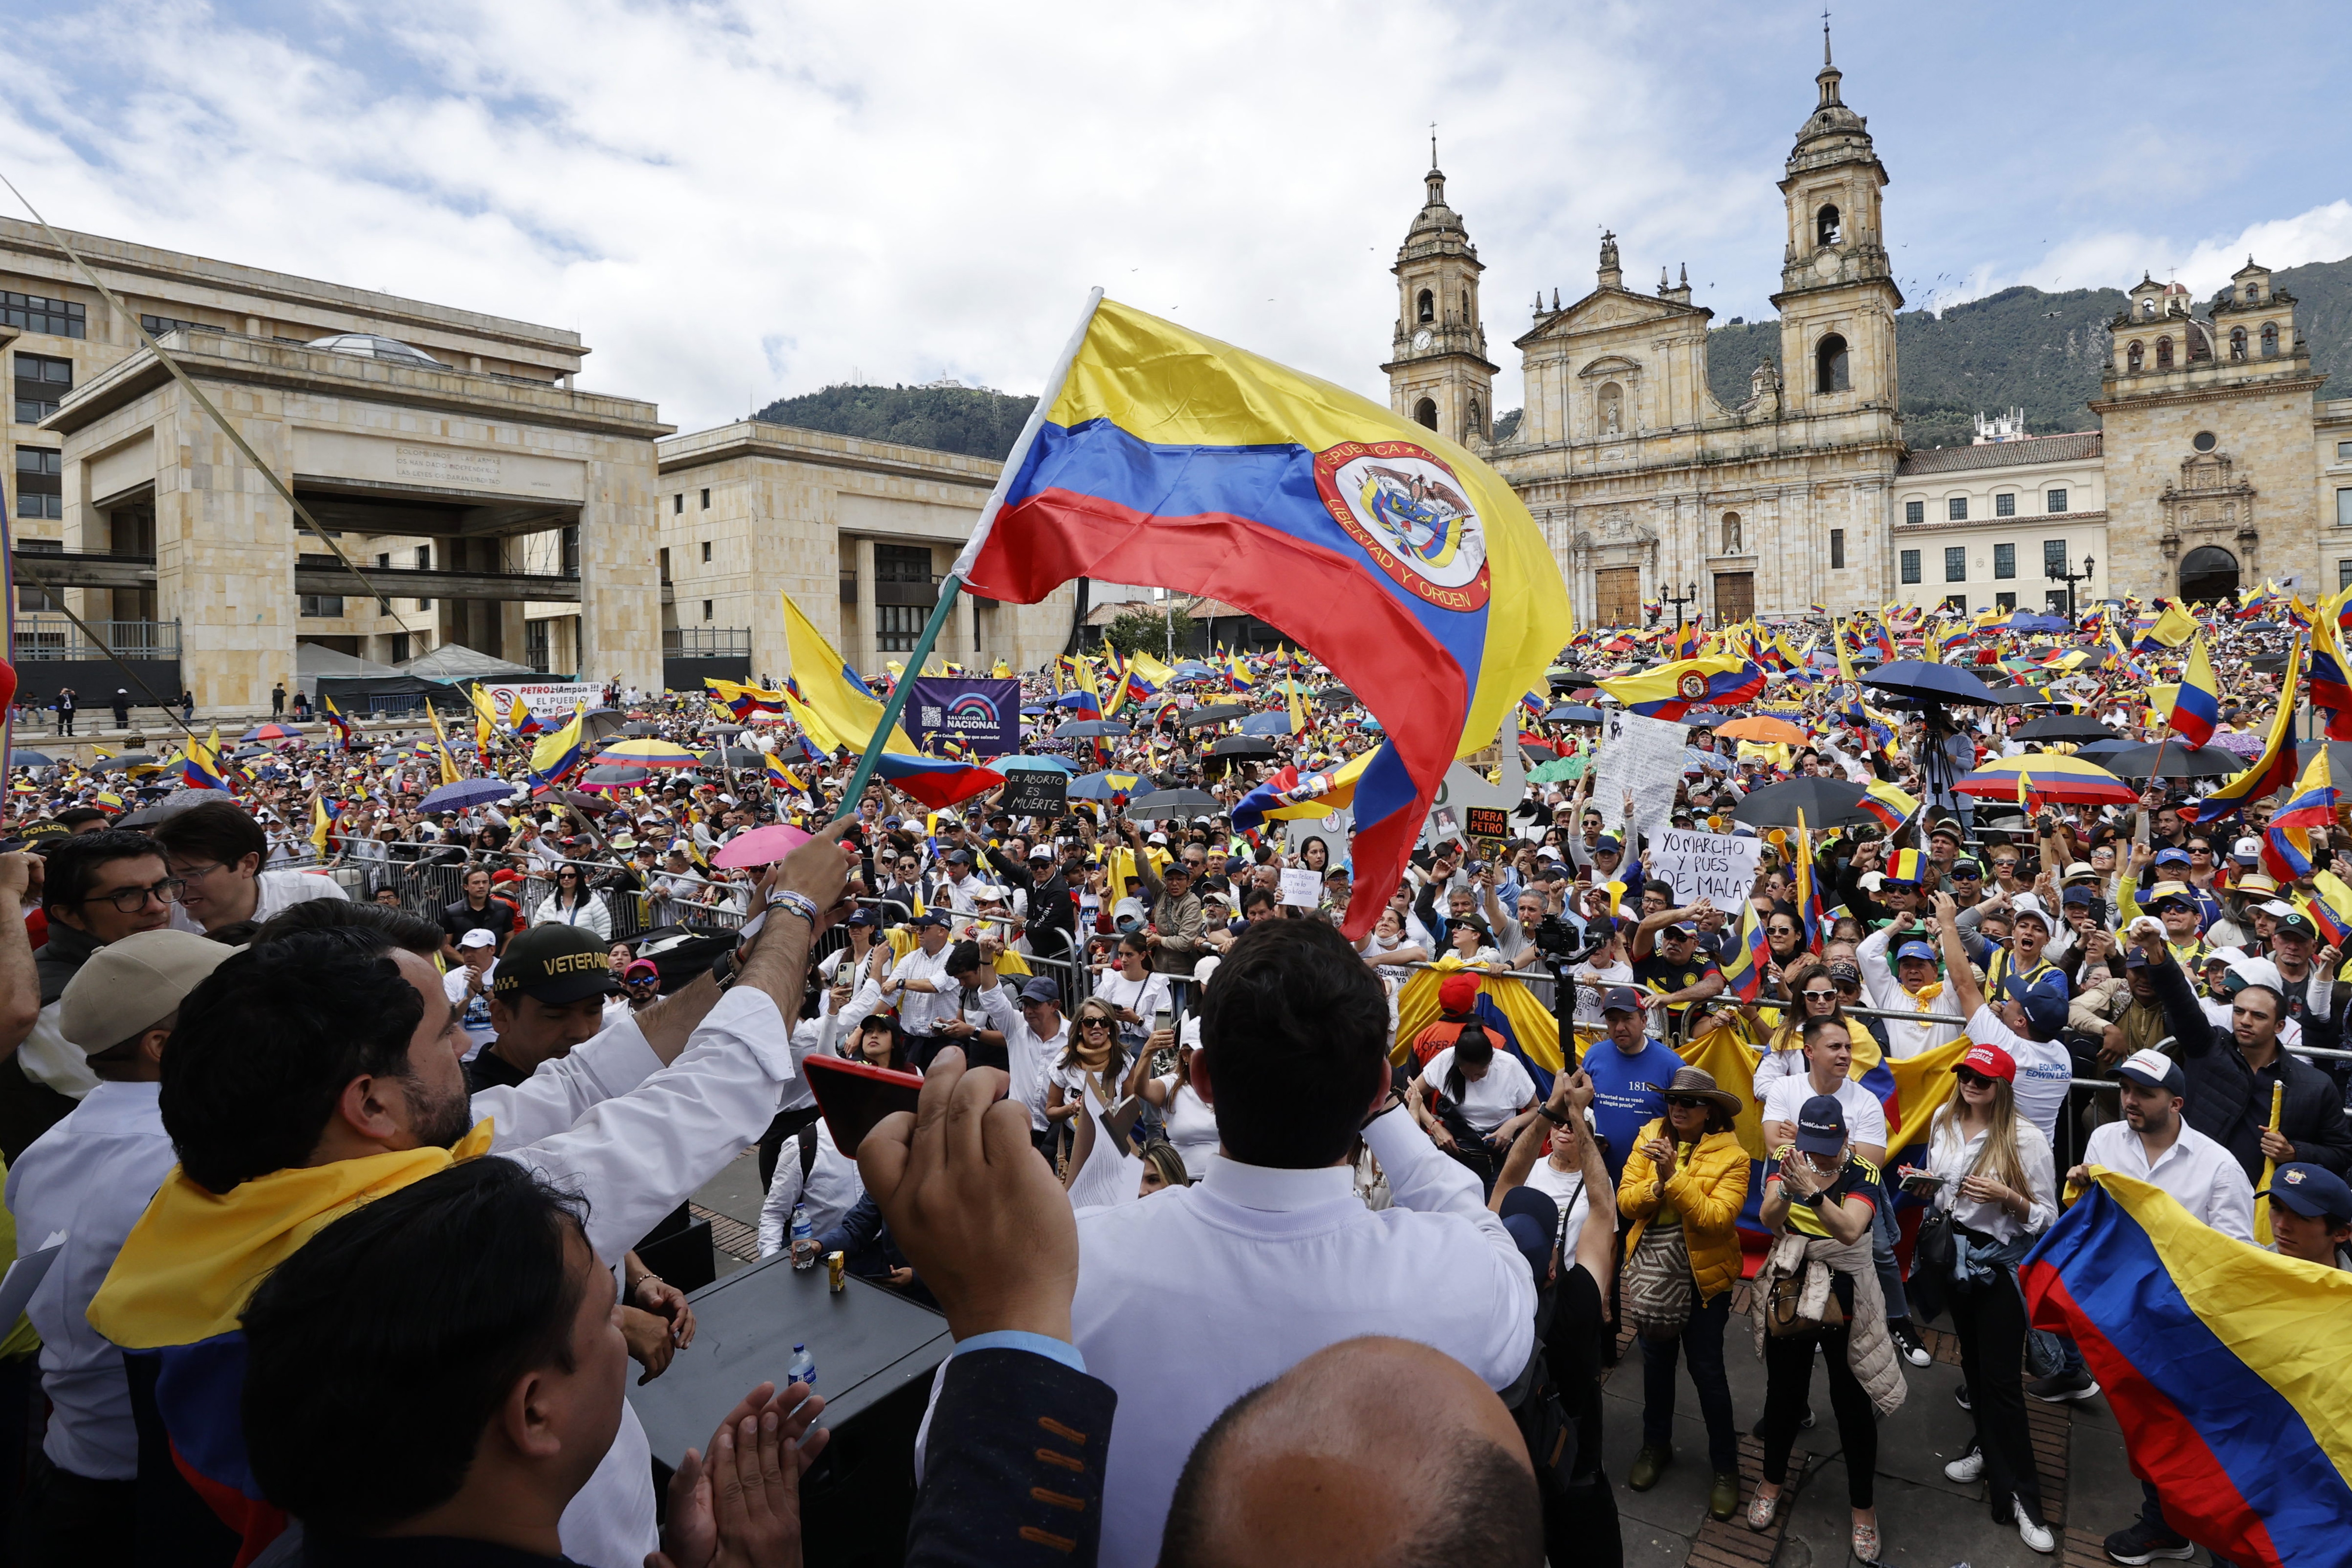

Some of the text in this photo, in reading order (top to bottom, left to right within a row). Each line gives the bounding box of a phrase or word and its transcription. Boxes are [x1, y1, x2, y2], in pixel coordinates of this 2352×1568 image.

[396, 448, 450, 459] COLOMBIANOS
[1421, 451, 1444, 468] DE
[426, 461, 447, 469] DADO
[449, 464, 500, 475] INDEPENDENCIA
[471, 476, 500, 485] LIBERTAD
[1328, 499, 1471, 607] LIBERTAD Y ORDEN
[947, 721, 1000, 729] NACIONAL
[1023, 774, 1063, 785] ABORTO
[1026, 787, 1040, 796] ES
[1011, 796, 1060, 811] MUERTE
[1472, 810, 1503, 823] FUERA
[21, 824, 70, 838] POLICIA
[1471, 821, 1502, 834] PETRO
[1663, 833, 1744, 856] YO MARCHO
[1677, 855, 1729, 873] Y PUES
[1954, 859, 1975, 867] DIGNITY
[1583, 990, 1601, 1008] FIELD
[2025, 1069, 2055, 1078] EDWIN
[2039, 1063, 2066, 1072] EQUIPO
